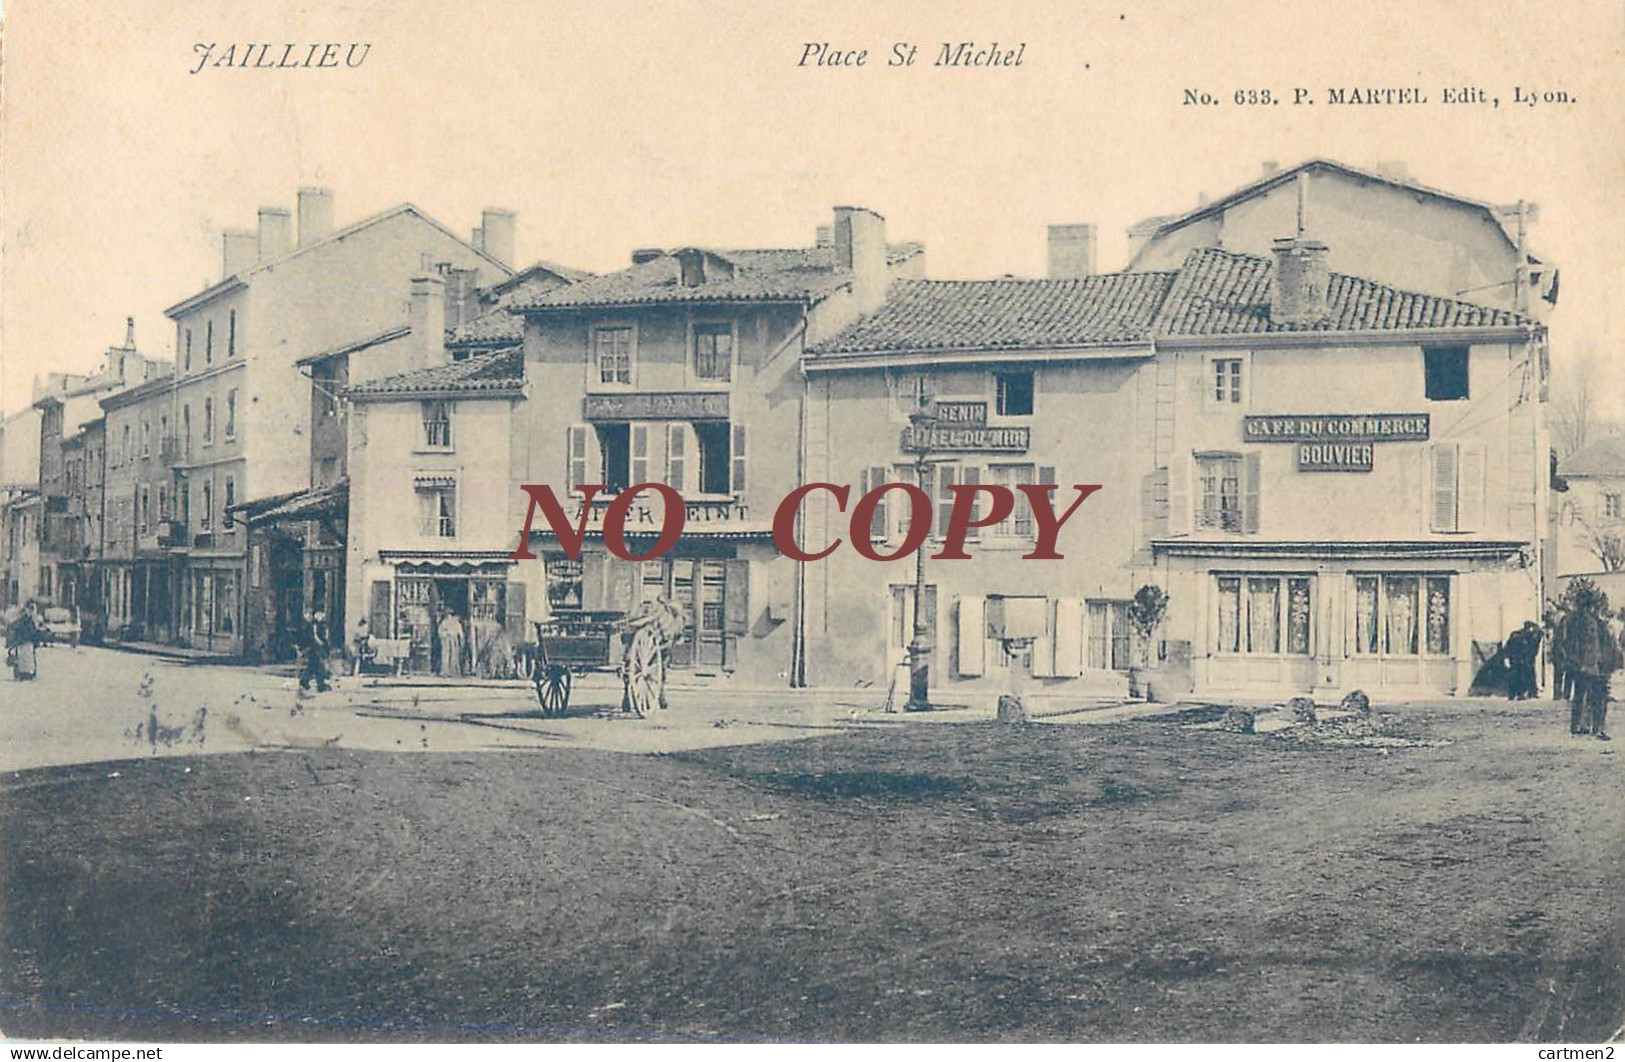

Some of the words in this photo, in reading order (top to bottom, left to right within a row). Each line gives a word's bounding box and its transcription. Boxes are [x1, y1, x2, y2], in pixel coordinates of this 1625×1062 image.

[938, 405, 985, 422] GENIN
[1247, 420, 1295, 436] CAFE
[1300, 420, 1323, 436] DU
[1327, 418, 1428, 435] COMMERCE
[1300, 444, 1372, 465] BOUVIER
